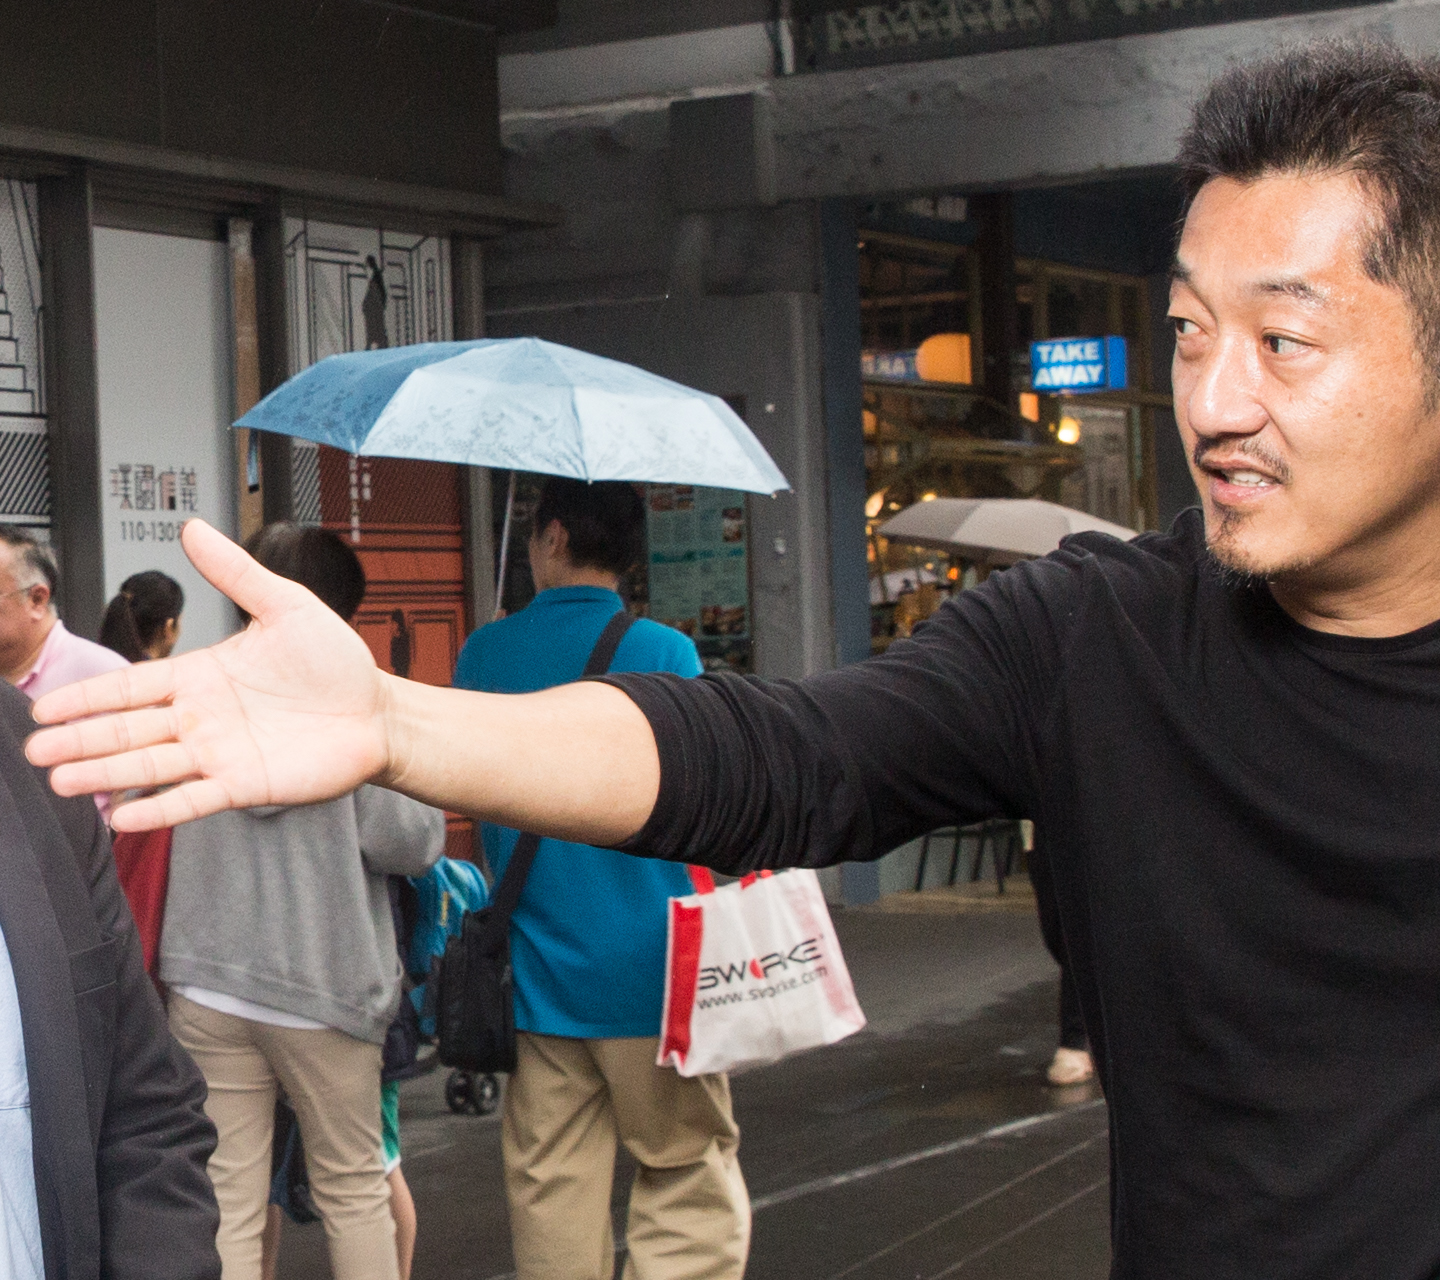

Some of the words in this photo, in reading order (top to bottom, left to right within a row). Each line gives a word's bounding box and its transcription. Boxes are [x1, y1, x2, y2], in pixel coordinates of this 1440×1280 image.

[1036, 341, 1100, 365] TAKE
[1034, 365, 1104, 388] AWAY
[121, 521, 184, 542] 110-130
